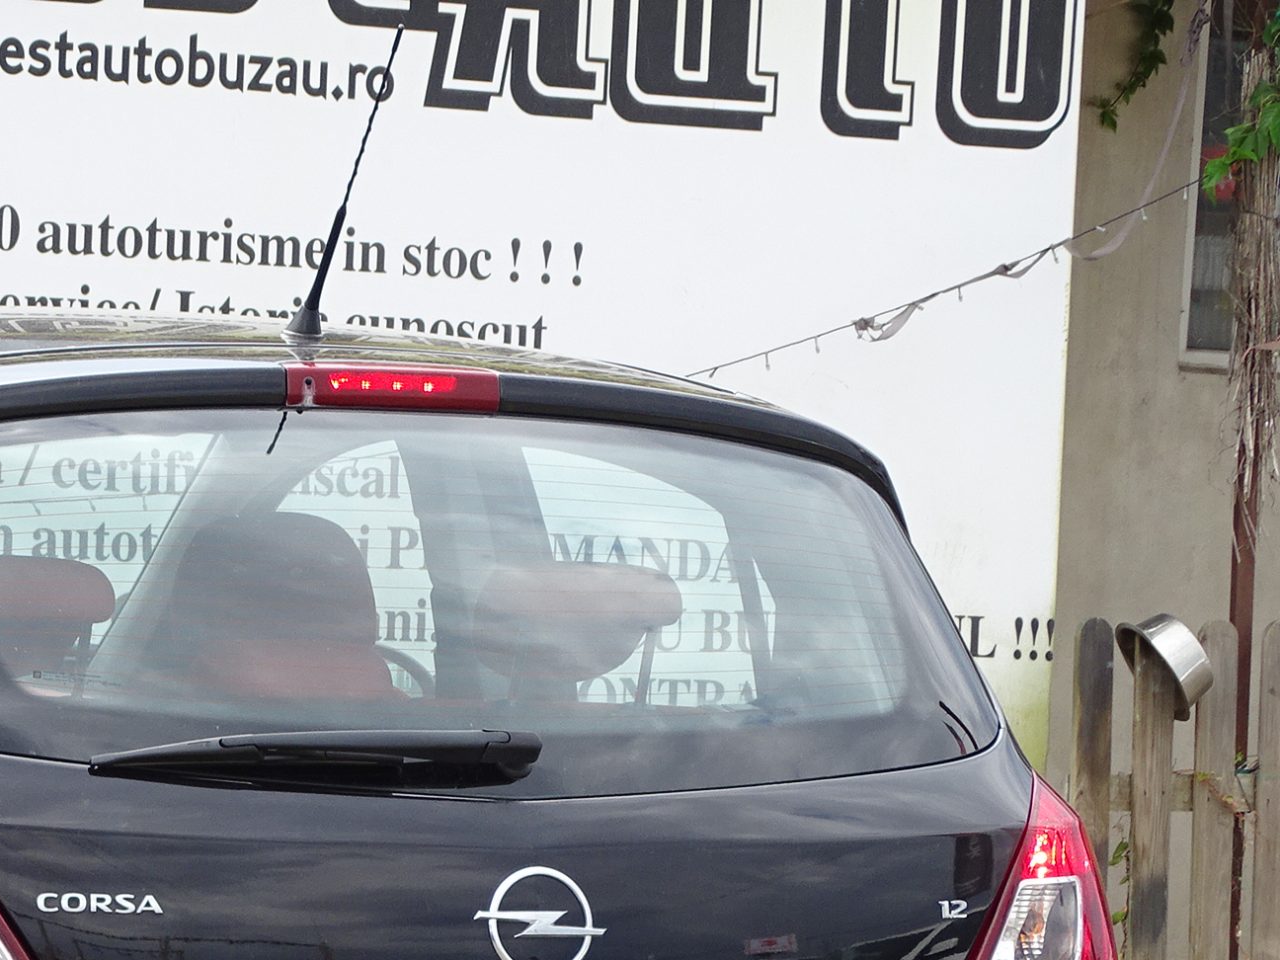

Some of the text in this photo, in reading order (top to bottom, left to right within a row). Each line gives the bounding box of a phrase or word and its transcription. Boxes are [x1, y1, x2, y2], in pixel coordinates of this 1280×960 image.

[36, 214, 326, 269] autoturisme
[343, 226, 387, 274] in
[402, 236, 492, 281] stoc
[36, 892, 164, 915] CORSA
